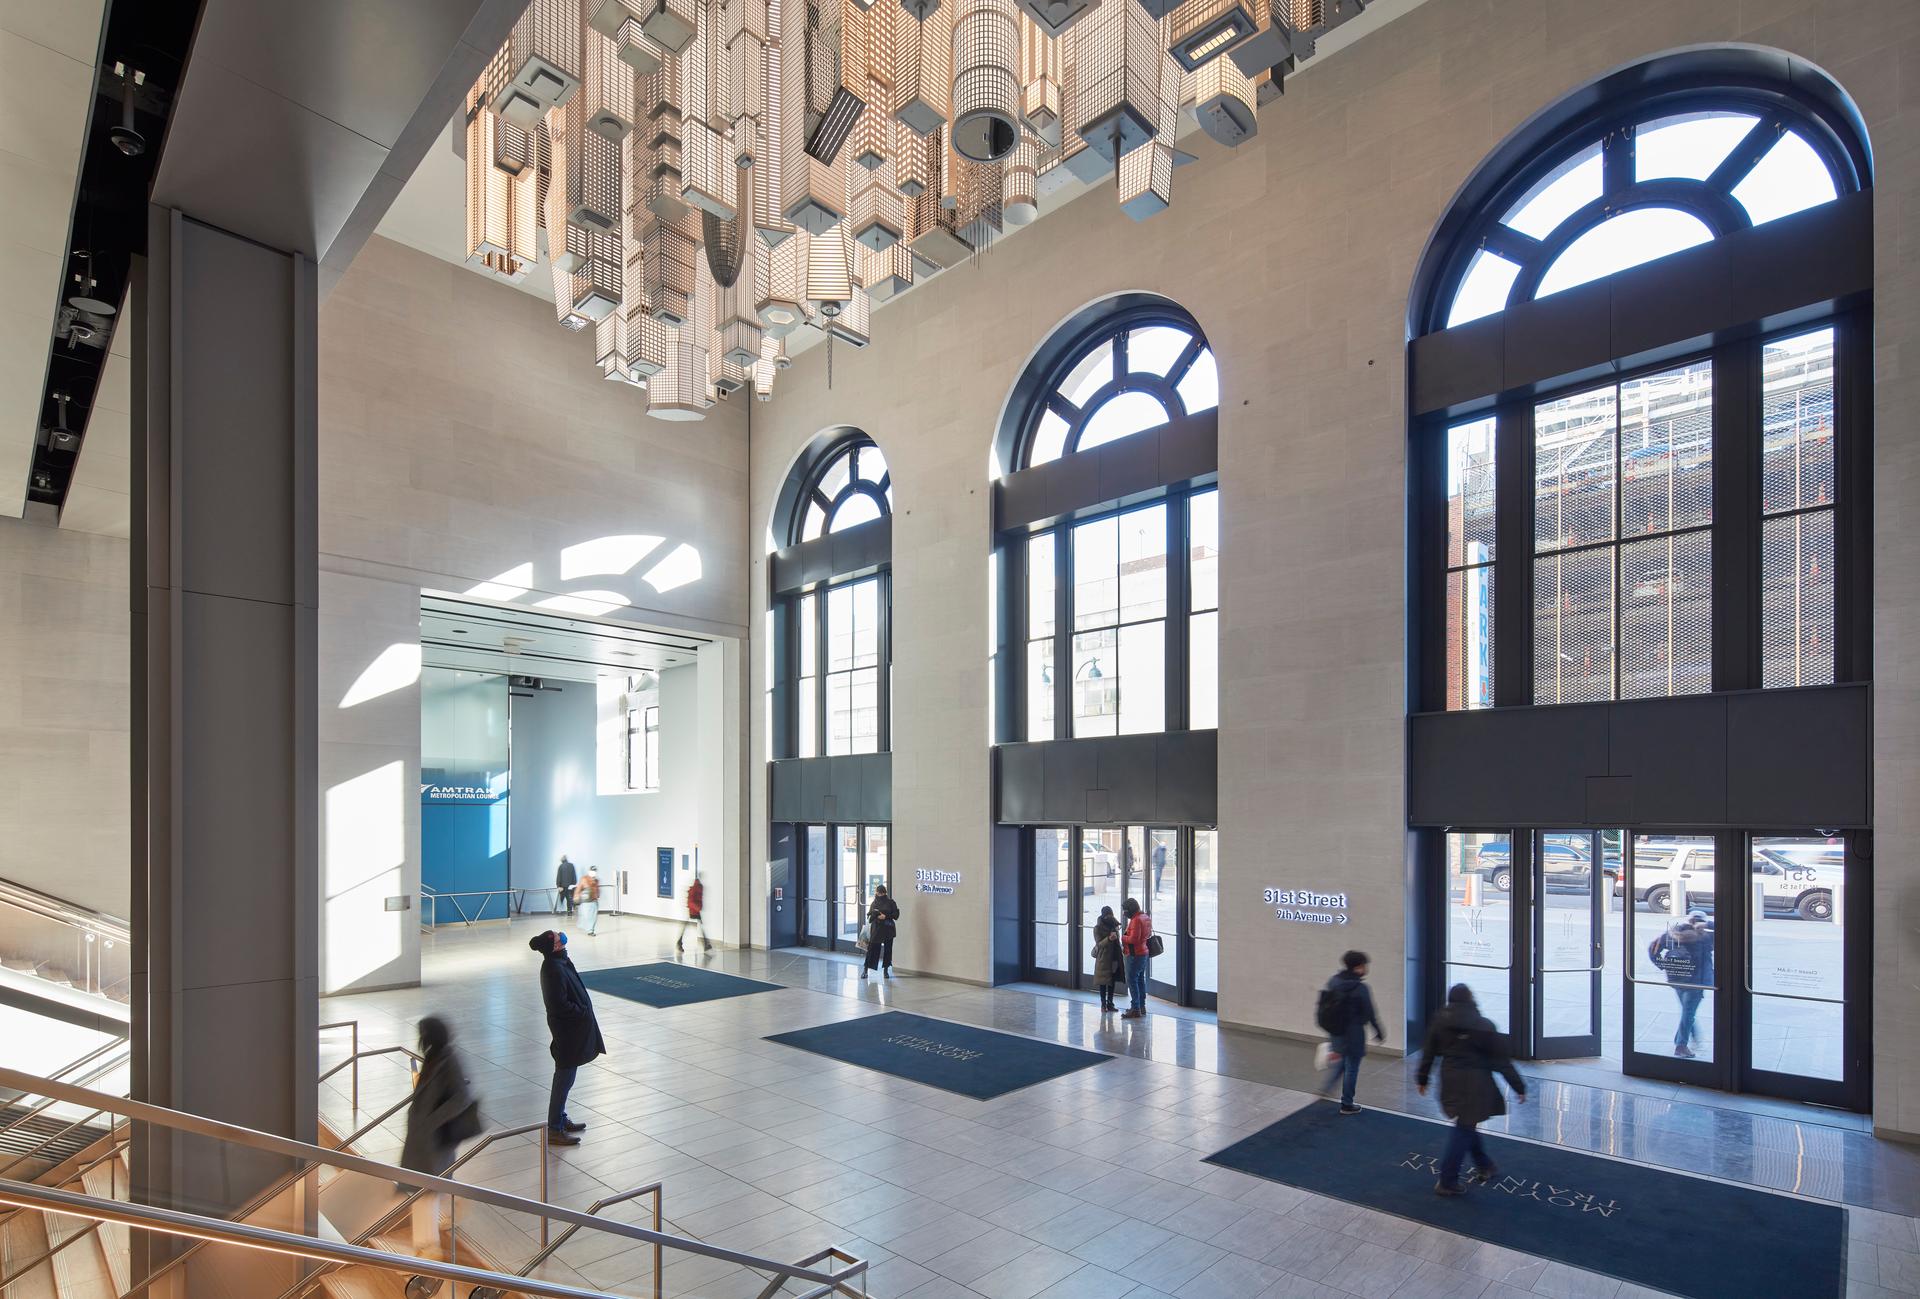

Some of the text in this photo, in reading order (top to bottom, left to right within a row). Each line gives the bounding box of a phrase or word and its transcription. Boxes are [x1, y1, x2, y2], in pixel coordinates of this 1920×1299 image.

[1479, 552, 1488, 667] PARK
[915, 869, 960, 882] 31st Street
[1264, 889, 1345, 907] 31st Street
[1276, 909, 1332, 923] 9th Avenue
[1407, 1152, 1621, 1210] TRAIN HLL
